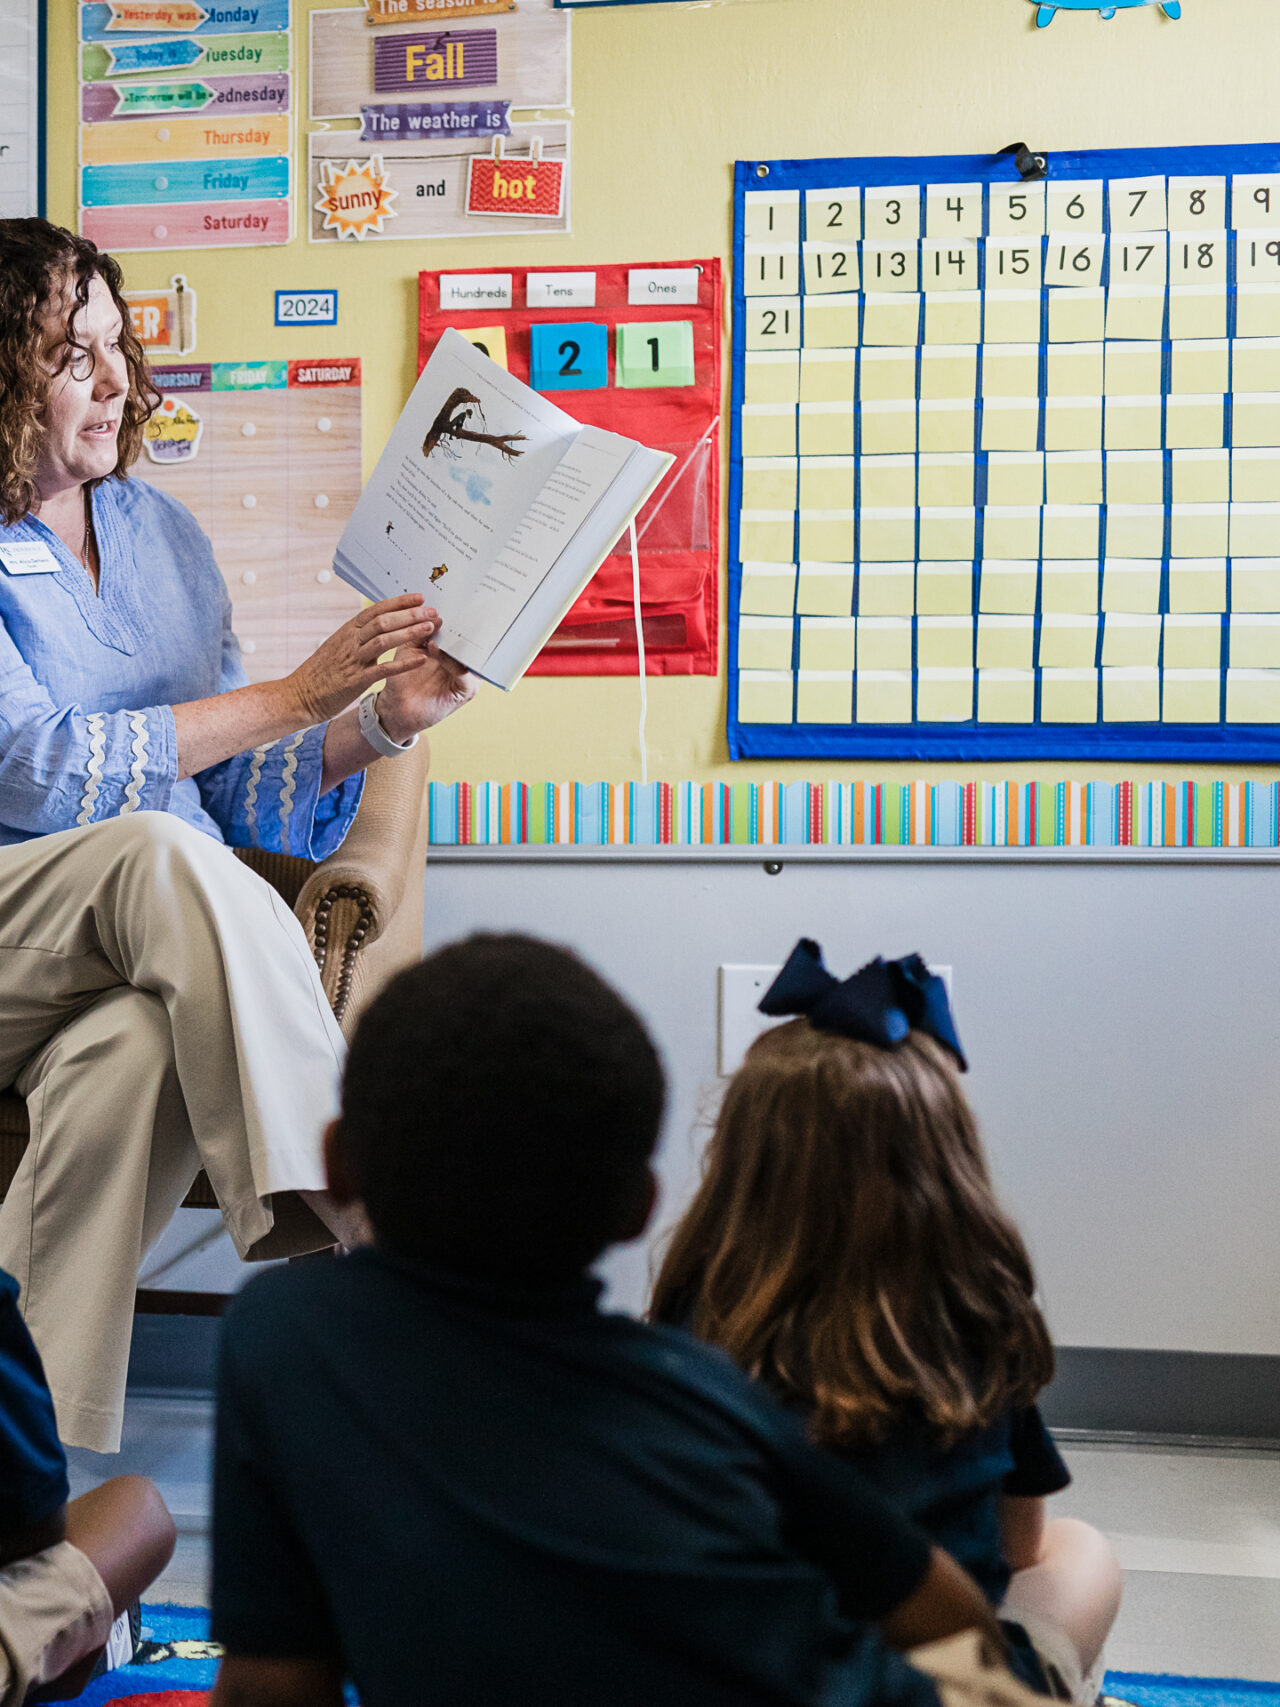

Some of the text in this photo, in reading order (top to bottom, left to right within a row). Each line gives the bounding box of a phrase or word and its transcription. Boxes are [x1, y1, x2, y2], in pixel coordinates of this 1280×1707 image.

[206, 7, 259, 24] Monday
[379, 0, 408, 14] The
[123, 10, 197, 23] Yesterday was
[136, 51, 163, 62] Today
[405, 43, 464, 81] Fall
[129, 90, 207, 102] Tomorrow will be
[216, 87, 285, 104] ednesday
[371, 110, 501, 131] The weather is
[204, 128, 271, 146] Thursday
[203, 173, 249, 191] Friday
[416, 179, 446, 197] and
[492, 171, 537, 200] hot
[329, 190, 383, 212] sunny
[769, 188, 1270, 231] 1 2 3 4 5 6 7 8 9
[203, 213, 269, 232] Saturday
[761, 241, 1280, 280] 11 12 13 14 15 16 17 18 19
[451, 286, 508, 299] Hundreds
[546, 284, 574, 297] Tens
[648, 281, 677, 294] Ones
[283, 298, 331, 317] 2024
[761, 310, 789, 335] 21
[558, 340, 582, 376] 2
[647, 338, 660, 372] 1
[230, 370, 268, 384] FRIDAY
[297, 367, 352, 382] SATURDAY
